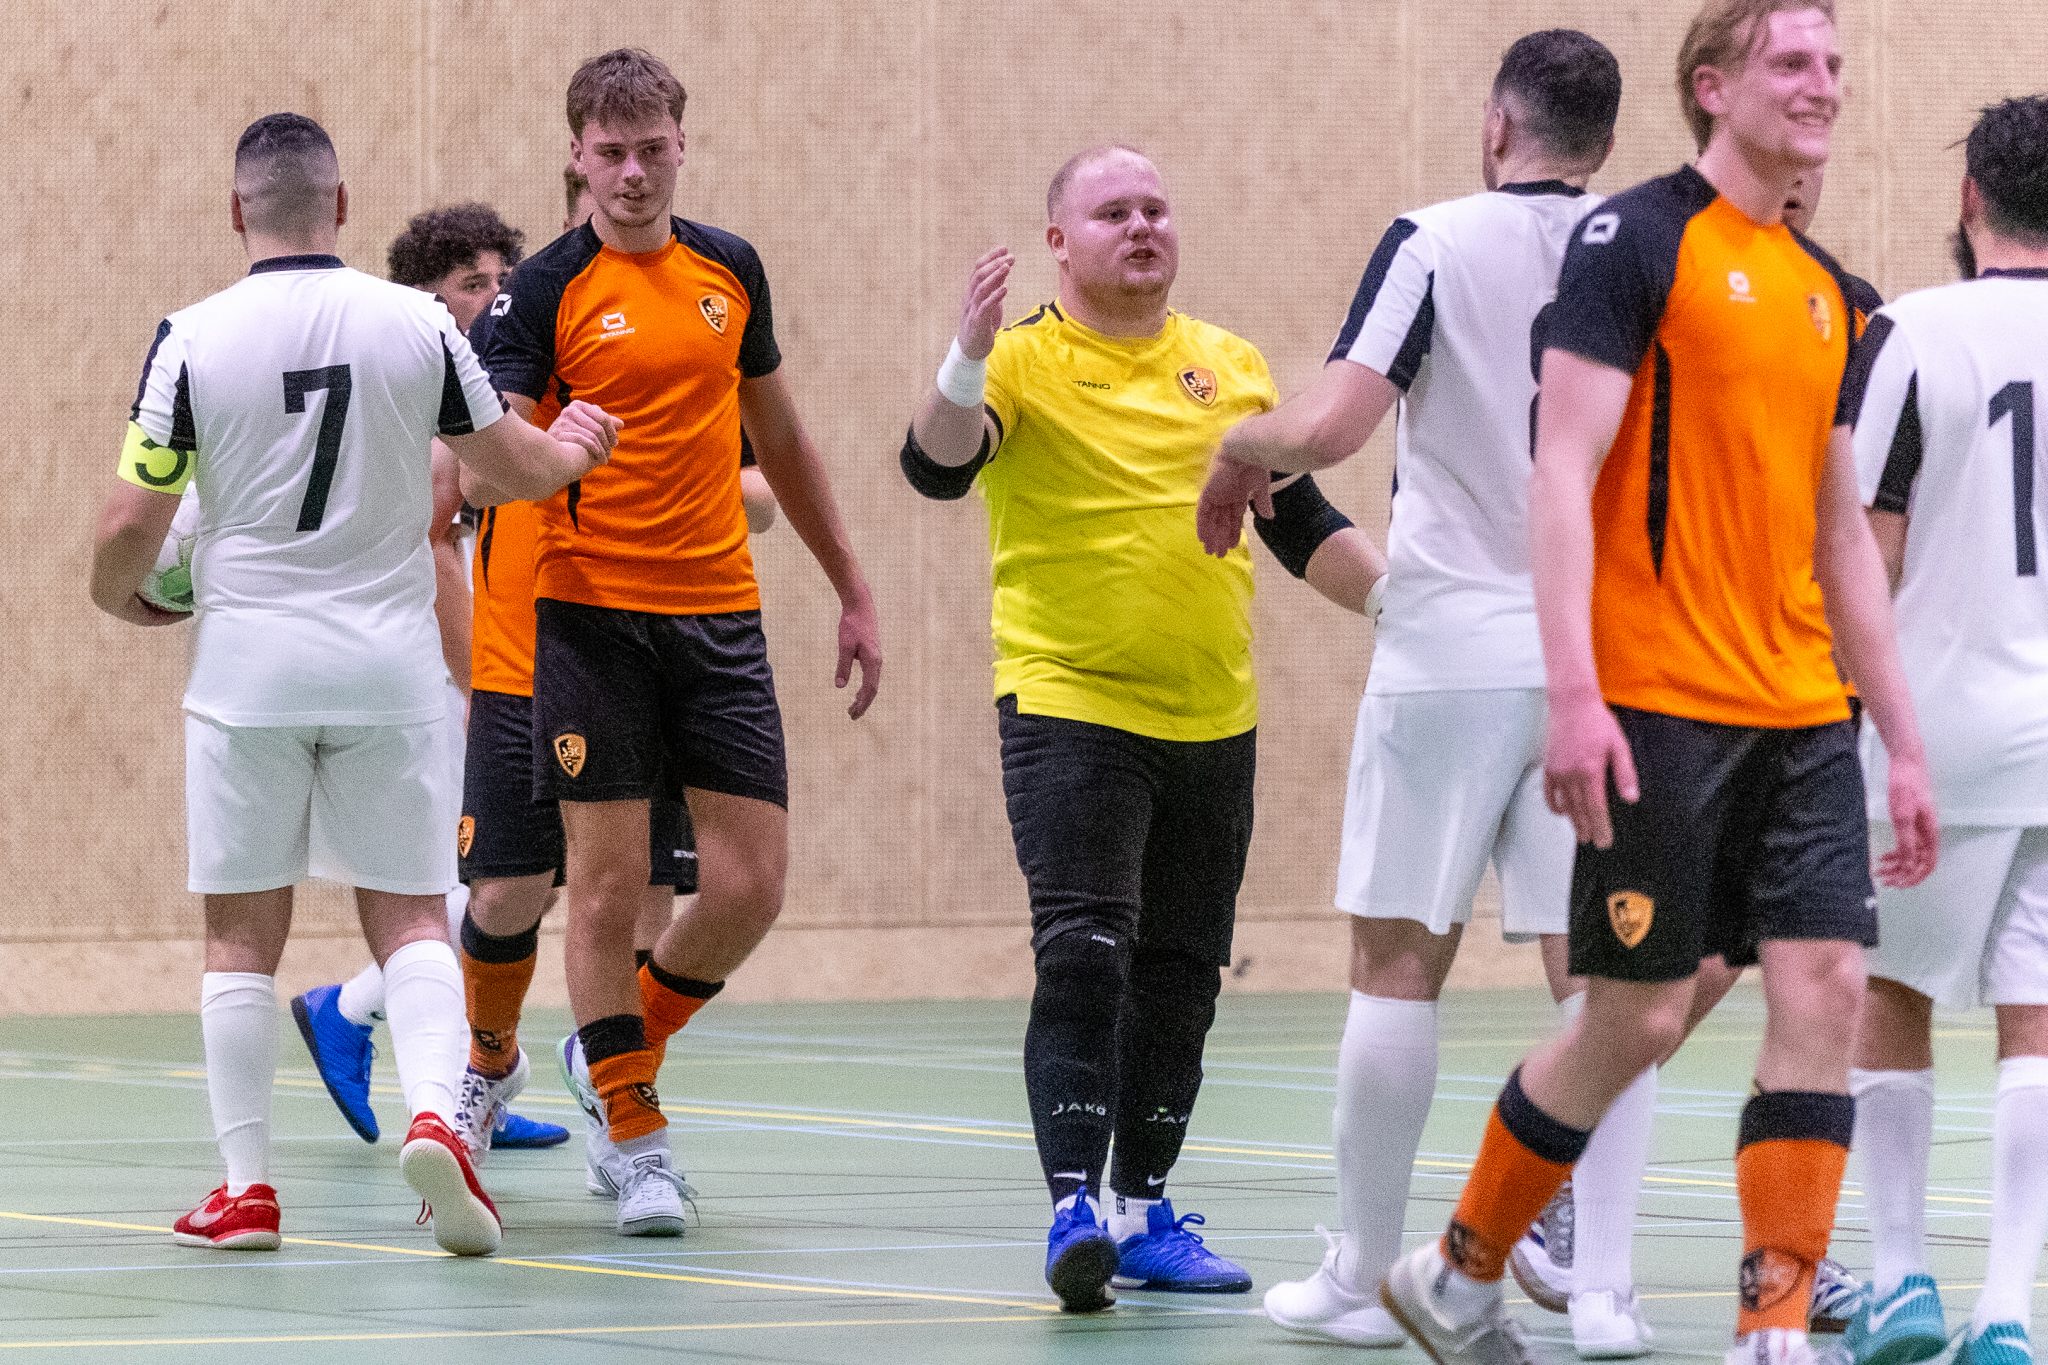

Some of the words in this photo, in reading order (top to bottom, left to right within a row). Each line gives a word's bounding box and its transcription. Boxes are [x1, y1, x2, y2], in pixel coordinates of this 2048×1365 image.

[1071, 380, 1111, 390] TANNO
[282, 363, 352, 532] 7
[1988, 380, 2037, 577] 1
[1091, 934, 1116, 947] ANNO
[1051, 1102, 1107, 1117] JAKO
[1146, 1113, 1190, 1124] JAK
